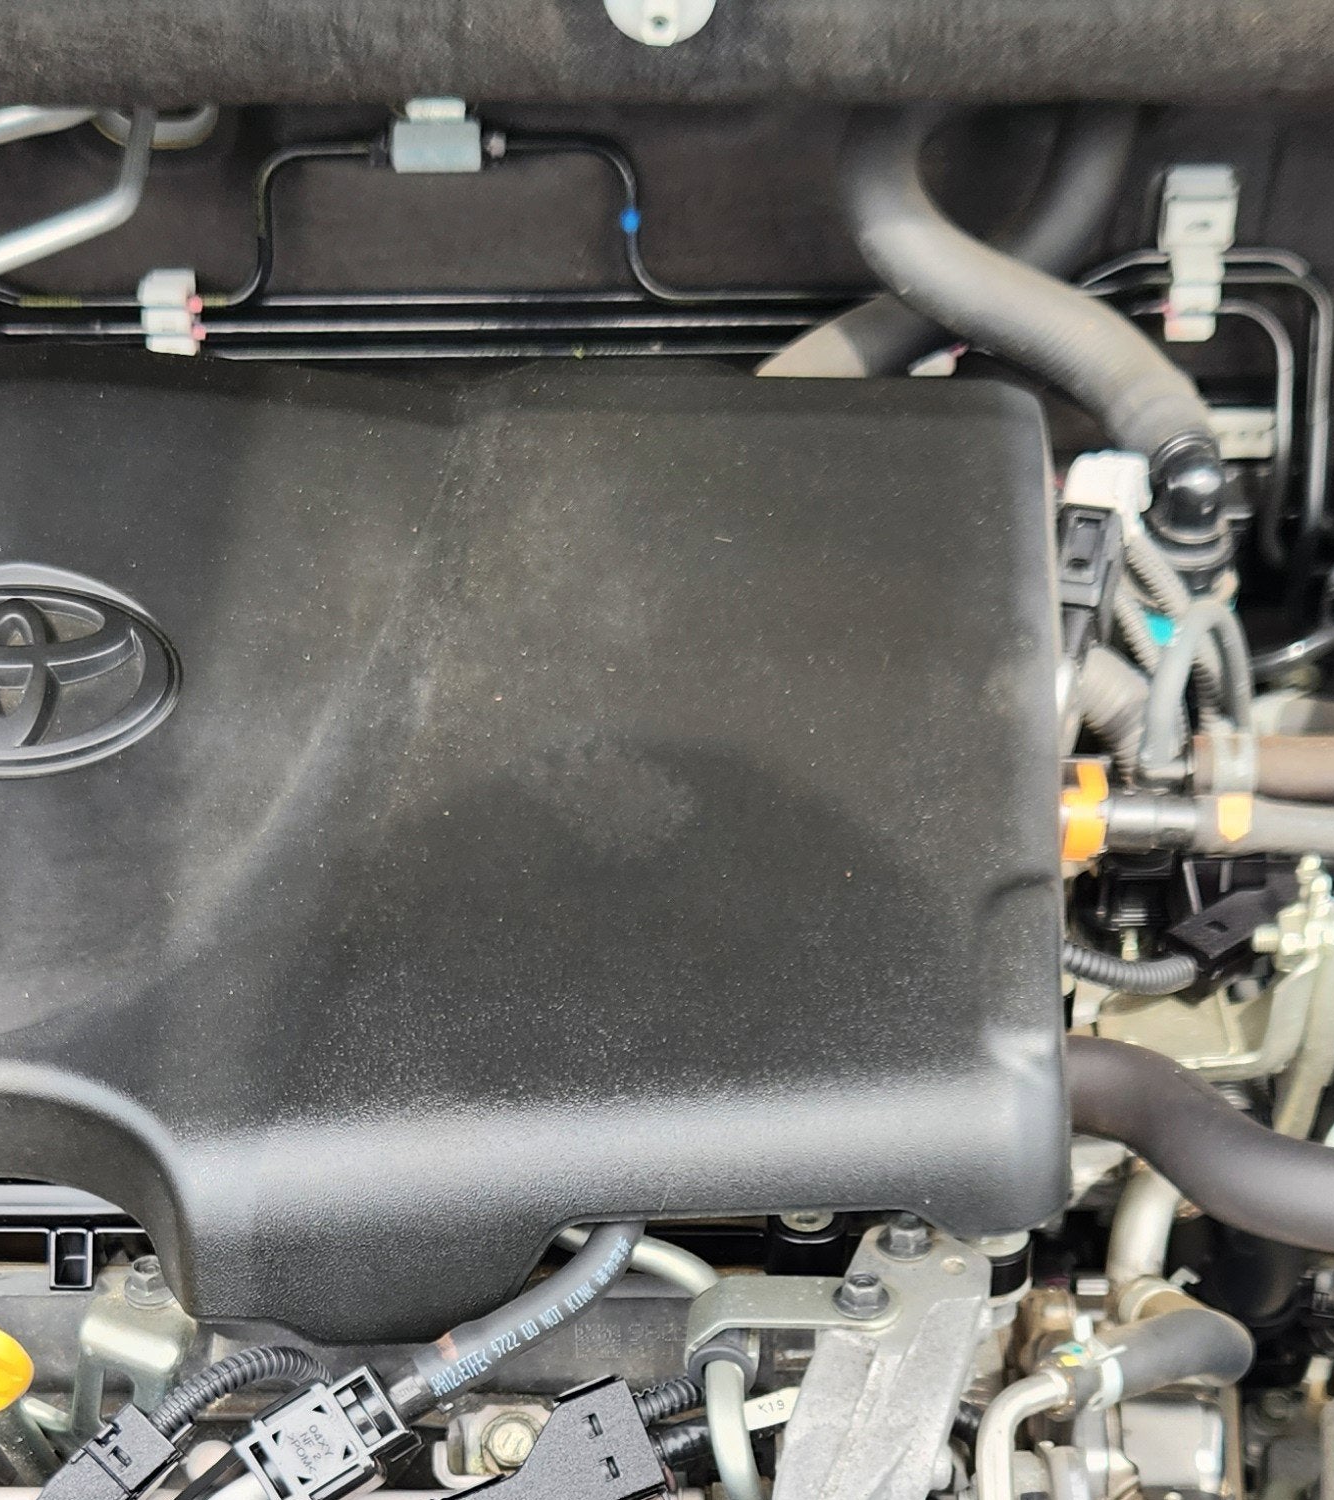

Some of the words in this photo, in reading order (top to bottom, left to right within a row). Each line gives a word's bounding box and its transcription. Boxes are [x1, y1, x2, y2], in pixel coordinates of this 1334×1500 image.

[490, 1330, 521, 1358] 9722
[521, 1320, 540, 1341] DO
[538, 1304, 565, 1330] NOT
[563, 1280, 598, 1314] KINK
